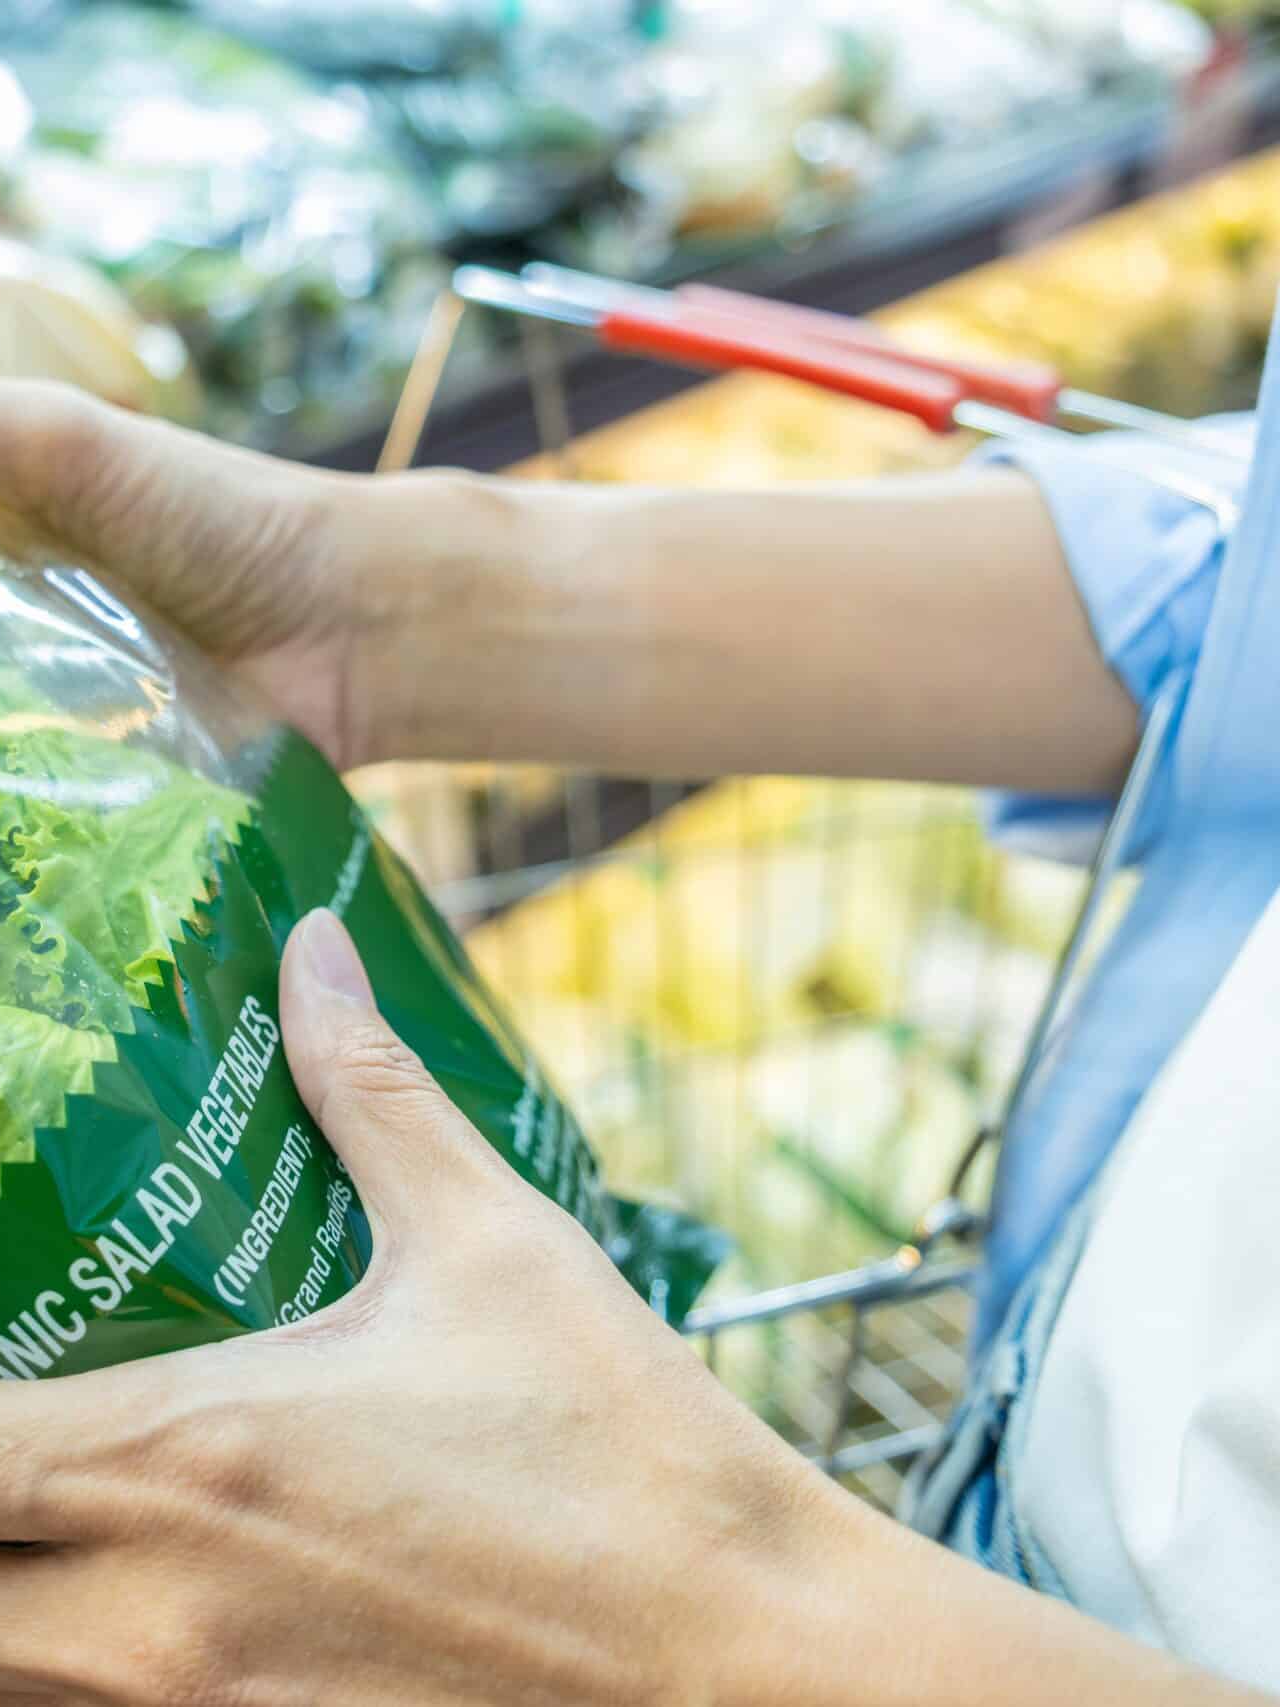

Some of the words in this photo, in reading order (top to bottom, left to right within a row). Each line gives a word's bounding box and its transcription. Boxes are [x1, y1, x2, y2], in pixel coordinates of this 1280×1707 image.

[68, 1163, 202, 1311] SALAD
[176, 995, 280, 1180] VEGETABLES
[213, 1123, 313, 1306] (INGREDIENT):
[274, 1246, 332, 1328] Grand
[316, 1179, 352, 1258] Rapids
